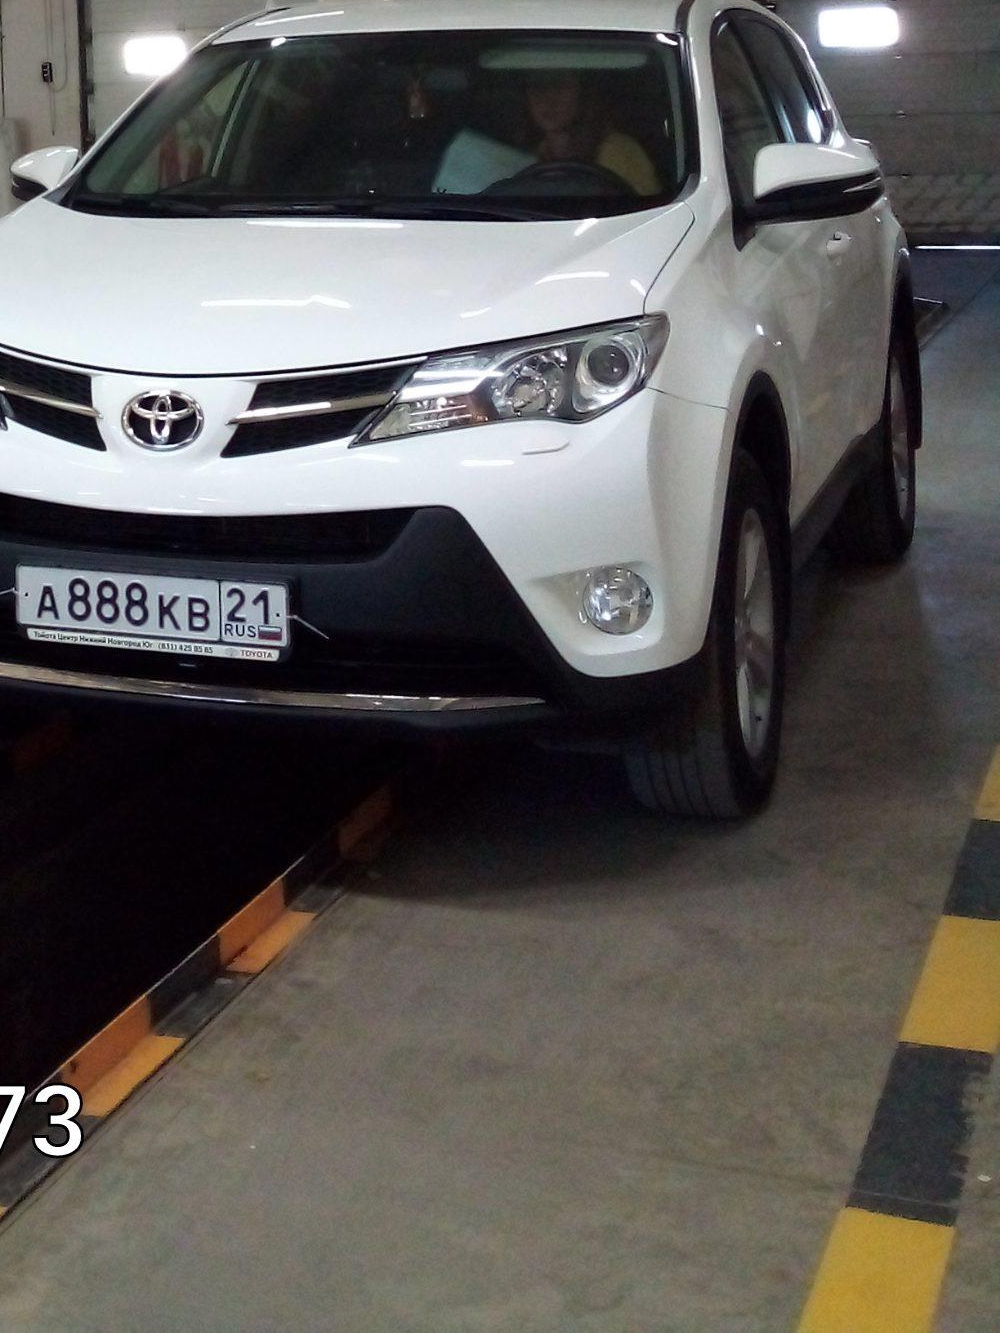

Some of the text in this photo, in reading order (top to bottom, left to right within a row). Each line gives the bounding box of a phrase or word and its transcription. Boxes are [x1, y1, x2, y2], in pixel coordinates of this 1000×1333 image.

[225, 587, 271, 625] 21
[224, 623, 256, 638] RUS
[57, 632, 78, 642] Центр
[107, 638, 141, 648] Новгород
[240, 649, 274, 659] TOYOTA
